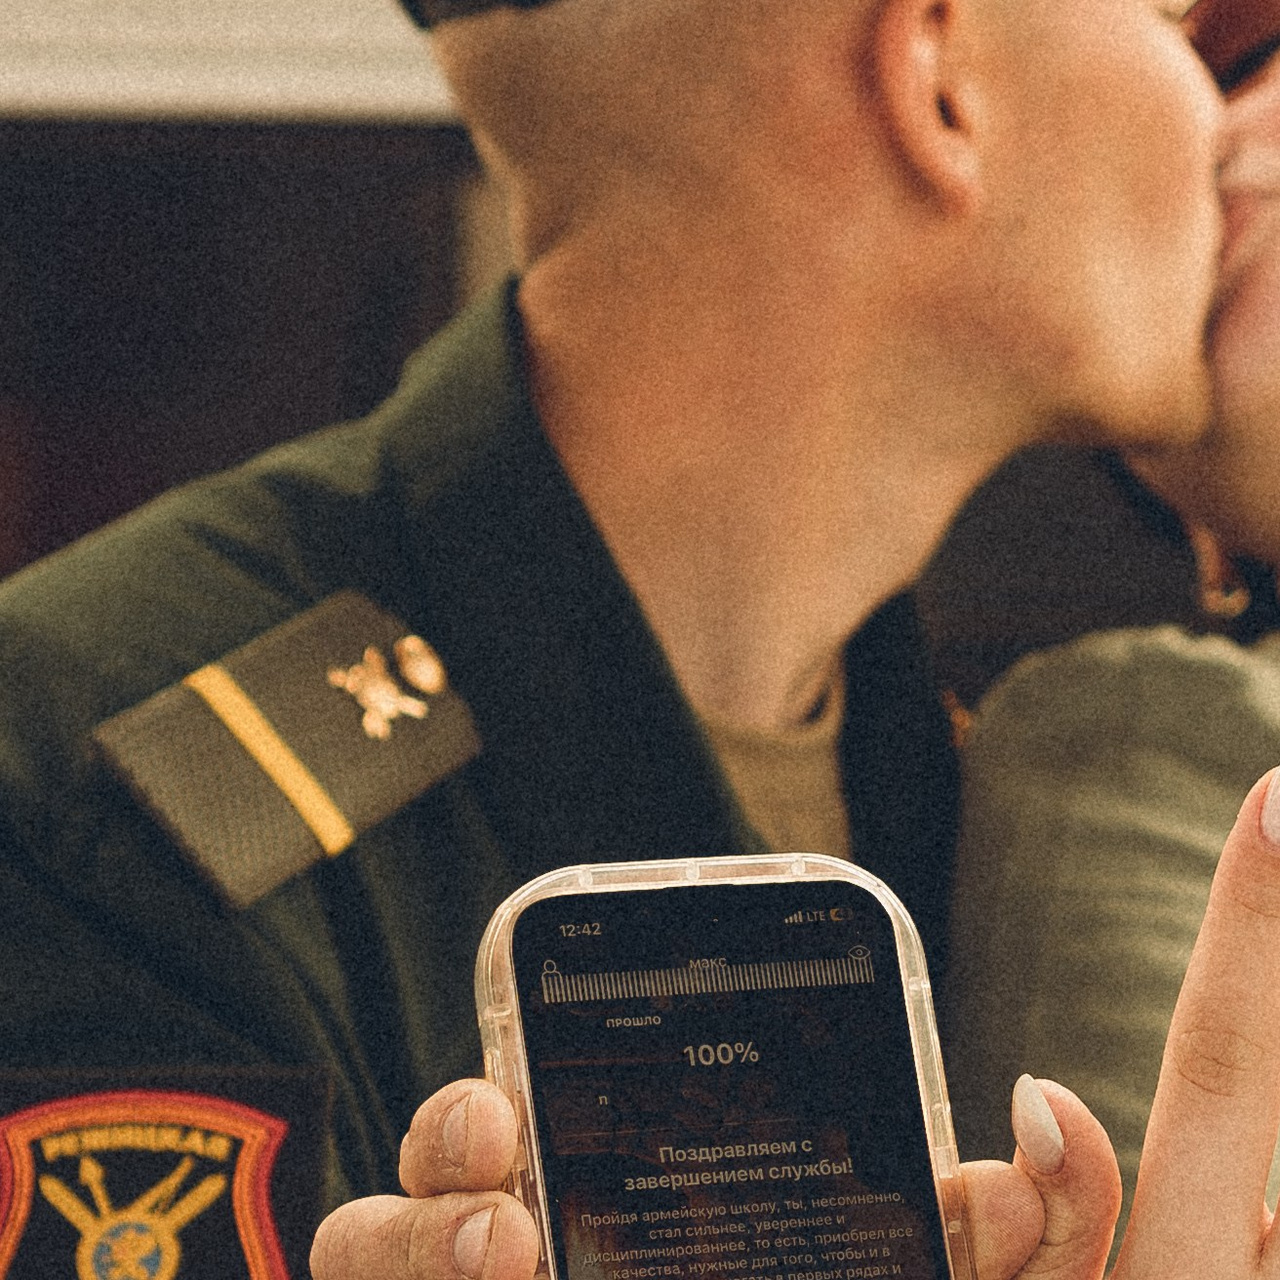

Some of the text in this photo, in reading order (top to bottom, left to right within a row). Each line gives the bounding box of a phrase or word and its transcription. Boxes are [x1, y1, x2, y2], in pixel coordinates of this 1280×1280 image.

[806, 910, 825, 921] LTE
[560, 923, 601, 937] 12:42
[606, 1016, 661, 1028] прошло
[683, 1042, 758, 1066] 100%
[659, 1140, 812, 1163] Поздравляем с
[624, 1158, 853, 1191] завершением службы!
[581, 1191, 905, 1228] Пройдя армейскую школу, ты, несомненно,
[649, 1214, 845, 1240] стал сильнее, увереннее и
[583, 1226, 913, 1265] дисциплинированнее, то есть, приобрел все
[613, 1247, 890, 1280] качества, нужные для того, чтобы и в
[846, 1264, 889, 1279] рядах
[892, 1264, 901, 1275] и
